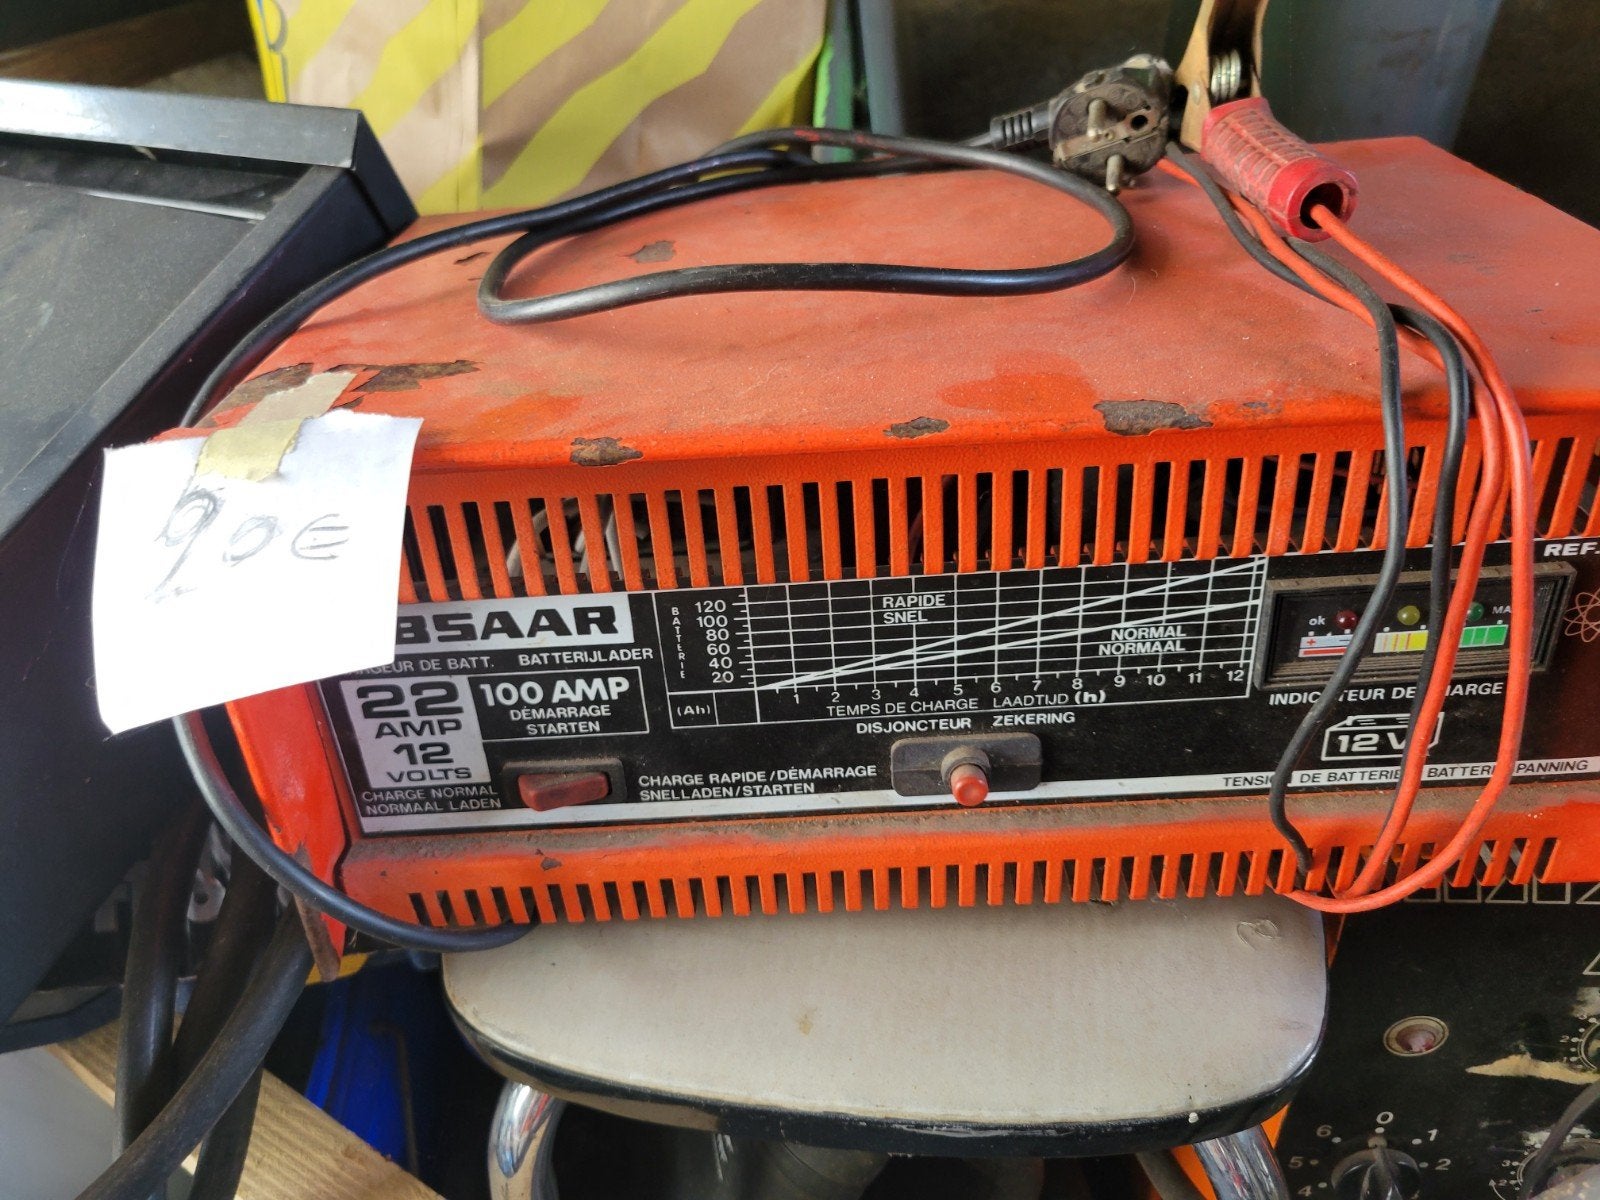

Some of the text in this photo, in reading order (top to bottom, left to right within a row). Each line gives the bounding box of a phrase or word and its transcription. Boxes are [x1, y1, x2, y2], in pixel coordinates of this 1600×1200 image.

[695, 600, 727, 613] 120
[882, 594, 946, 608] RAPIDE
[882, 610, 929, 623] SNEL
[1492, 605, 1512, 614] MA
[395, 605, 619, 645] BSAAR
[696, 614, 728, 628] 100
[1308, 616, 1326, 626] ok
[705, 628, 730, 641] 80
[1111, 625, 1187, 641] NORMAL
[671, 606, 687, 680] BATTERIE
[706, 643, 731, 656] 60
[1098, 640, 1186, 656] NORMAAL
[420, 658, 442, 671] DE
[447, 655, 495, 671] BATT.
[518, 647, 654, 667] BATTERIJLADER
[708, 656, 733, 669] 40
[711, 671, 735, 684] 20
[480, 676, 630, 707] 100 AMP
[793, 669, 1244, 705] 1 2 3 4 5 6 7 8 9 10 11 12
[356, 679, 464, 721] 22
[826, 689, 1107, 717] TEMPS DE CHARGE LAADTIJD (h)
[1269, 689, 1385, 706] INDICTEUR
[1391, 687, 1416, 699] DE
[509, 704, 612, 721] DÉMARRAGE
[676, 704, 711, 717] (Ah)
[375, 718, 463, 740] AMP
[525, 721, 601, 736] STARTEN
[856, 712, 1076, 734] DISJONCTEUR ZEKERING
[393, 742, 454, 766] 12
[386, 766, 473, 783] VOLTS
[638, 773, 704, 788] CHARGE
[1300, 772, 1321, 784] DE
[1326, 767, 1402, 783] BATTERIE
[362, 784, 498, 803] CHARGE NORMAL
[639, 782, 816, 802] SNELLADEN/STARTEN
[364, 796, 502, 816] NORMAAL LADEN
[1376, 1111, 1394, 1125] 0
[1316, 1124, 1332, 1138] 6
[1427, 1128, 1438, 1142] 1
[1288, 1156, 1303, 1169] 5
[1435, 1158, 1452, 1171] 2
[1299, 1185, 1313, 1197] 4
